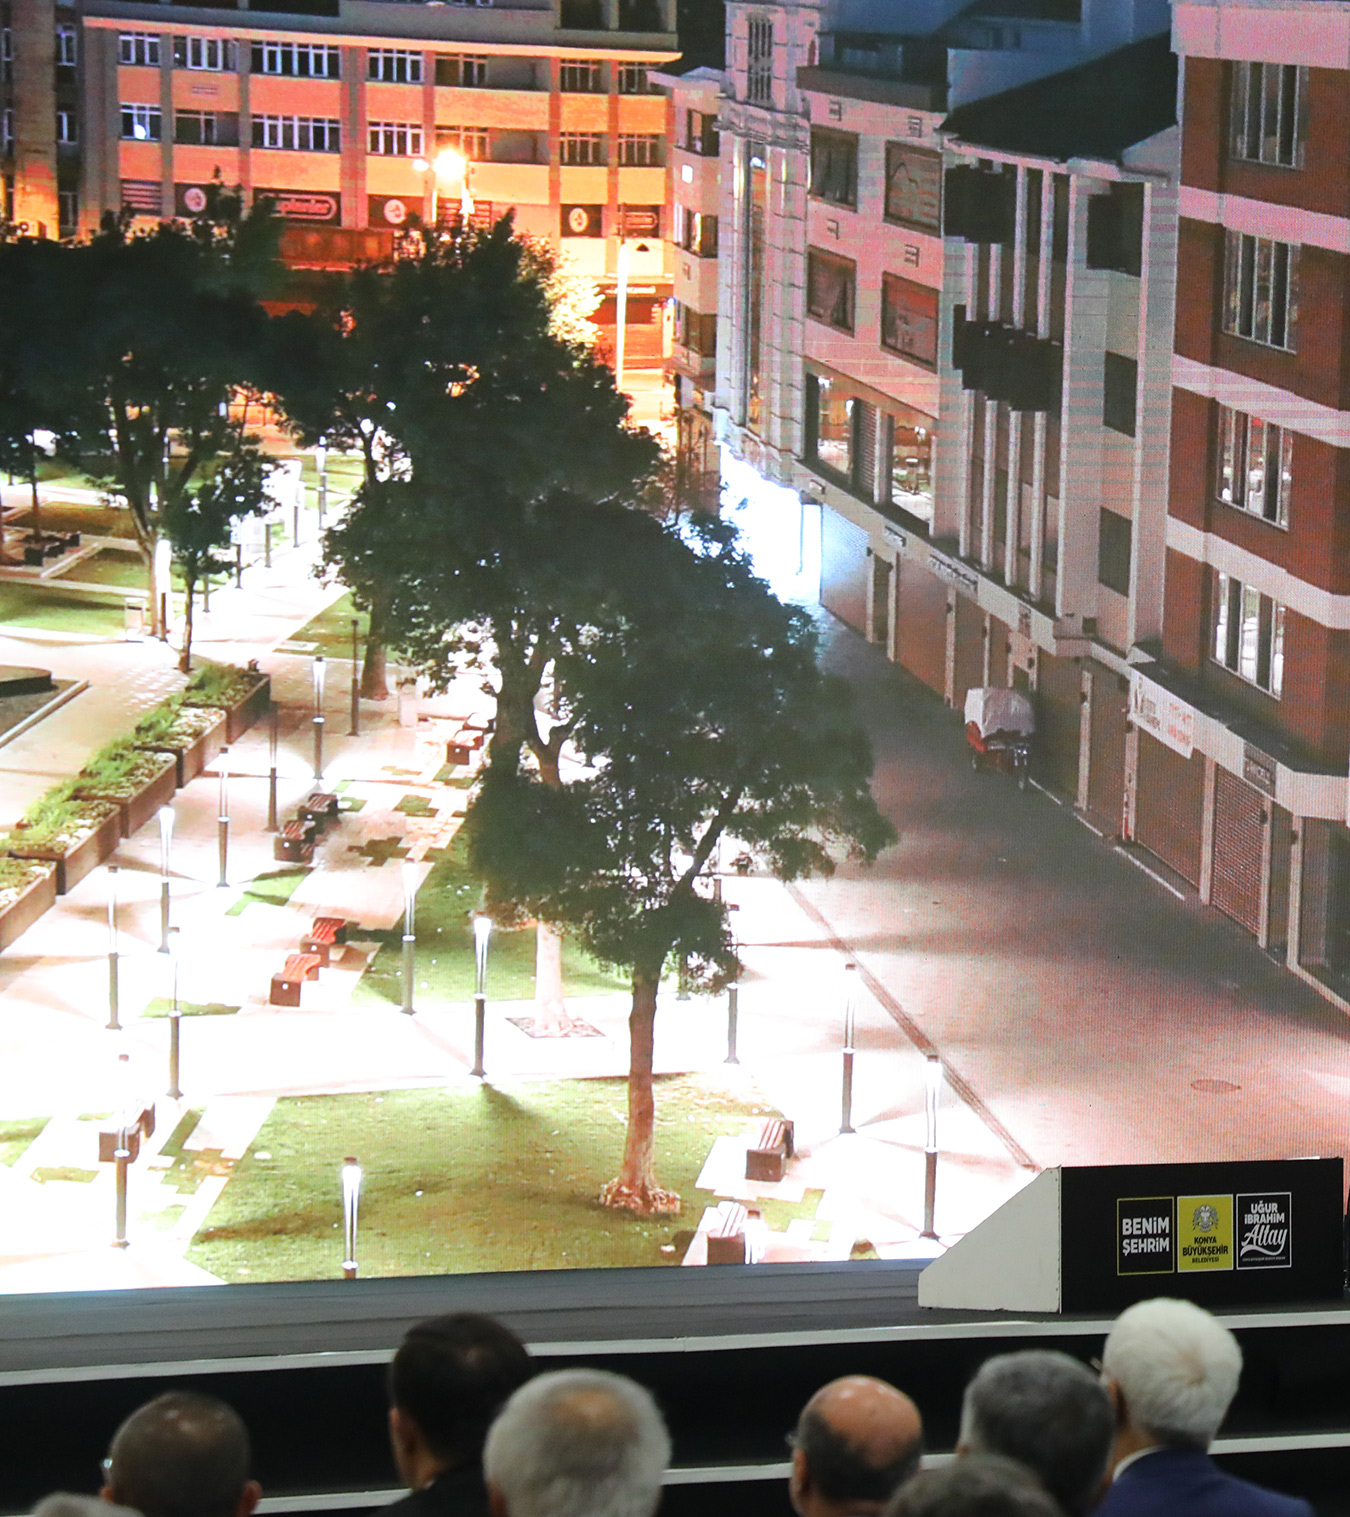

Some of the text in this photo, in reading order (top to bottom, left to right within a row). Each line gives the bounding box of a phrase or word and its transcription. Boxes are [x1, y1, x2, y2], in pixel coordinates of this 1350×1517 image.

[1250, 1200, 1278, 1214] UĞUR
[1193, 1235, 1217, 1245] KONYA
[1240, 1224, 1288, 1257] Altay
[1182, 1244, 1229, 1257] BÜYÜKŞEHİR
[1191, 1256, 1220, 1264] BELEDİYESİ
